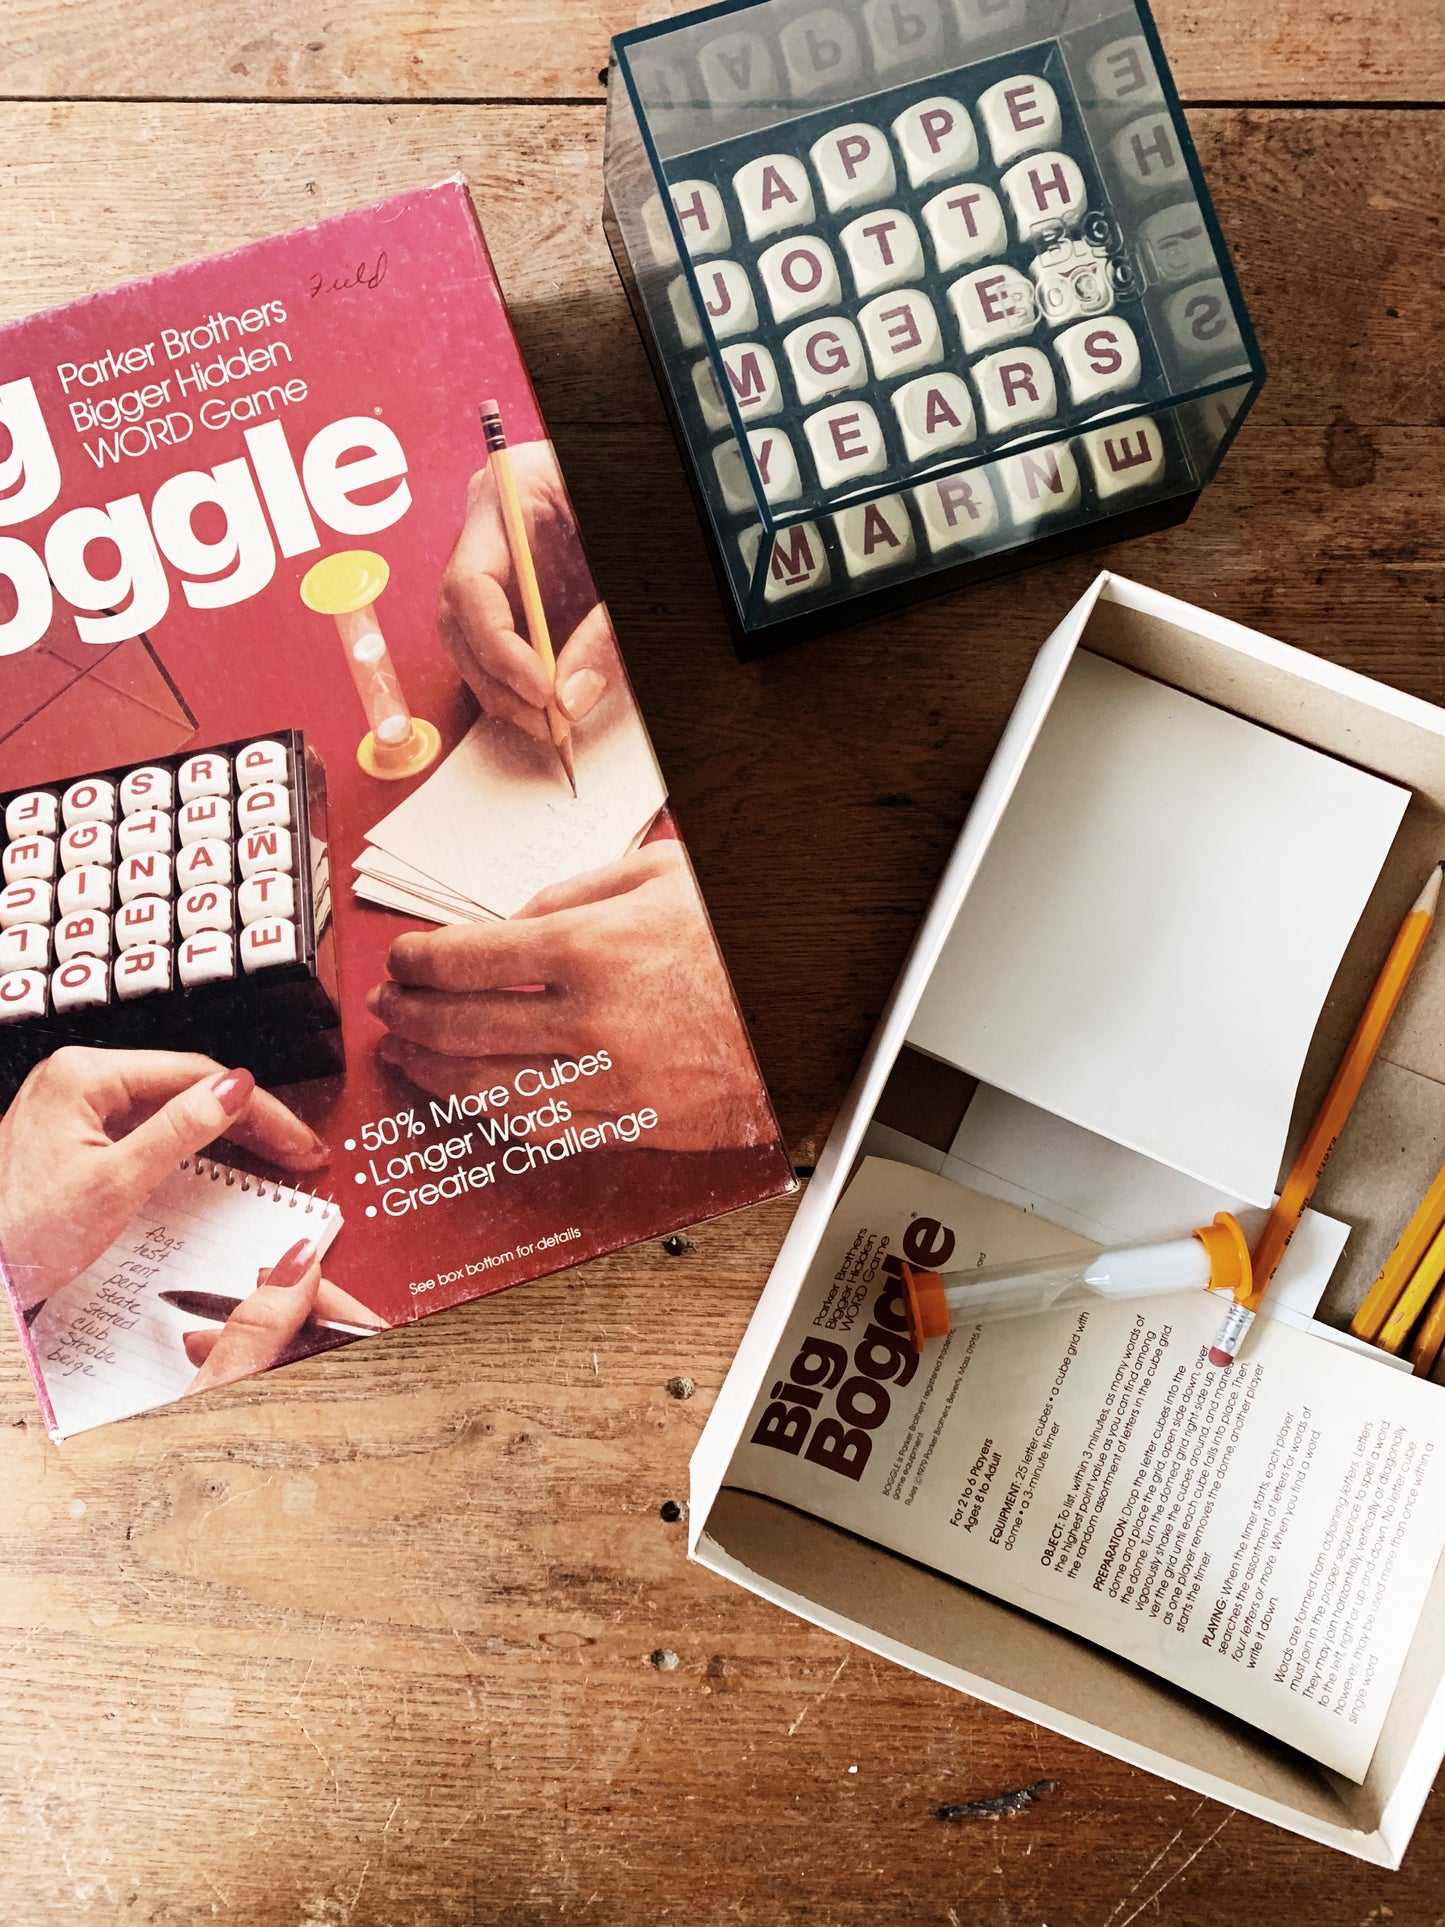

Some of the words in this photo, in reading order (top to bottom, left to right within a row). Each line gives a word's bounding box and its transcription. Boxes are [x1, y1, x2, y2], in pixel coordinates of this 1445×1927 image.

[672, 191, 709, 233] H
[760, 165, 798, 212] A
[837, 135, 871, 179] P
[918, 107, 954, 154] P
[1003, 83, 1044, 130] E
[706, 272, 732, 317] J
[781, 250, 822, 292] O
[862, 221, 899, 266] T
[946, 193, 981, 237] T
[1027, 162, 1072, 211] H
[57, 338, 156, 393] Parker
[160, 299, 288, 358] Brothers
[721, 352, 764, 407] M
[805, 330, 850, 375] G
[974, 273, 1015, 323] E
[69, 377, 174, 433] Bigger
[177, 340, 292, 392] Hidden
[829, 412, 869, 461] E
[925, 388, 962, 433] A
[998, 361, 1038, 407] R
[1083, 330, 1122, 374] S
[82, 411, 194, 468] WORD
[199, 378, 309, 428] Game
[770, 523, 816, 584] M
[862, 503, 901, 555] A
[940, 478, 982, 527] R
[1021, 455, 1064, 499] N
[191, 760, 212, 783] R
[189, 847, 214, 870] A
[252, 877, 276, 901] T
[361, 1108, 425, 1151] 50%
[429, 1085, 509, 1128] More
[514, 1049, 612, 1097] Cubes
[369, 1132, 474, 1186] Longer
[477, 1097, 572, 1147] Words
[382, 1161, 496, 1217] Greater
[502, 1107, 659, 1175] Challenge
[134, 1244, 170, 1261] test
[408, 1278, 436, 1296] See
[437, 1268, 464, 1286] box
[465, 1250, 515, 1276] bottom
[516, 1243, 535, 1260] for
[537, 1227, 581, 1251] details
[812, 1282, 841, 1327] Parker
[833, 1227, 868, 1282] Brothers
[824, 1283, 854, 1331] Bigger
[845, 1234, 878, 1284] Hidden
[838, 1284, 868, 1332] WORD
[861, 1235, 891, 1284] Game
[1075, 1311, 1090, 1333] with
[1135, 1313, 1146, 1328] of
[1158, 1324, 1173, 1348] grid.
[1067, 1333, 1081, 1356] grid
[1122, 1328, 1141, 1359] words
[1055, 1356, 1072, 1386] cube
[1110, 1359, 1130, 1392] many
[1146, 1348, 1164, 1377] cube
[1172, 1365, 1187, 1384] the
[922, 1359, 943, 1400] registered
[1051, 1386, 1060, 1396] a
[1137, 1377, 1152, 1396] the
[1163, 1384, 1179, 1405] into
[751, 1334, 848, 1457] Big
[1105, 1392, 1116, 1406] as
[1134, 1397, 1145, 1408] in
[1034, 1403, 1054, 1437] cubes
[1042, 1421, 1060, 1450] timer
[1087, 1408, 1111, 1451] minutes,
[1119, 1408, 1140, 1441] letters
[1152, 1405, 1171, 1440] cubes
[897, 1431, 914, 1457] Parker
[1021, 1436, 1039, 1466] letter
[1082, 1450, 1093, 1460] 3
[1117, 1439, 1127, 1454] of
[1139, 1439, 1158, 1468] letter
[1353, 1422, 1374, 1458] Letters
[895, 1456, 904, 1464] is
[969, 1437, 994, 1478] Players
[983, 1452, 1002, 1483] Adult
[1014, 1464, 1029, 1481] 25
[881, 1462, 902, 1497] BOGGLE
[892, 1475, 907, 1501] game
[966, 1477, 977, 1486] 6
[977, 1482, 990, 1495] to
[1022, 1451, 1049, 1500] 3-minute
[1071, 1460, 1090, 1491] within
[1094, 1453, 1122, 1514] assortment
[1132, 1469, 1147, 1488] the
[1340, 1461, 1359, 1496] letters.
[957, 1498, 969, 1508] 2
[960, 1486, 973, 1499] to
[974, 1494, 985, 1504] 8
[1020, 1499, 1030, 1510] a
[1062, 1493, 1078, 1509] list,
[1121, 1488, 1140, 1517] Drop
[949, 1507, 965, 1527] For
[963, 1503, 982, 1534] Ages
[988, 1480, 1023, 1545] EQUIPMENT:
[1057, 1509, 1071, 1521] To
[1323, 1496, 1349, 1551] adjoining
[1004, 1516, 1023, 1552] dome
[1040, 1521, 1066, 1567] OBJECT:
[1076, 1514, 1099, 1560] random
[1066, 1560, 1082, 1579] the
[1092, 1516, 1129, 1592] PREPARATION:
[1309, 1552, 1327, 1579] from
[1176, 1602, 1194, 1634] starts
[1185, 1582, 1201, 1603] the
[1193, 1551, 1212, 1582] timer.
[1293, 1579, 1318, 1625] formed
[1259, 1597, 1278, 1631] down.
[1254, 1631, 1266, 1641] it
[1288, 1625, 1302, 1647] are
[1246, 1641, 1263, 1669] write
[1272, 1647, 1295, 1684] Words
